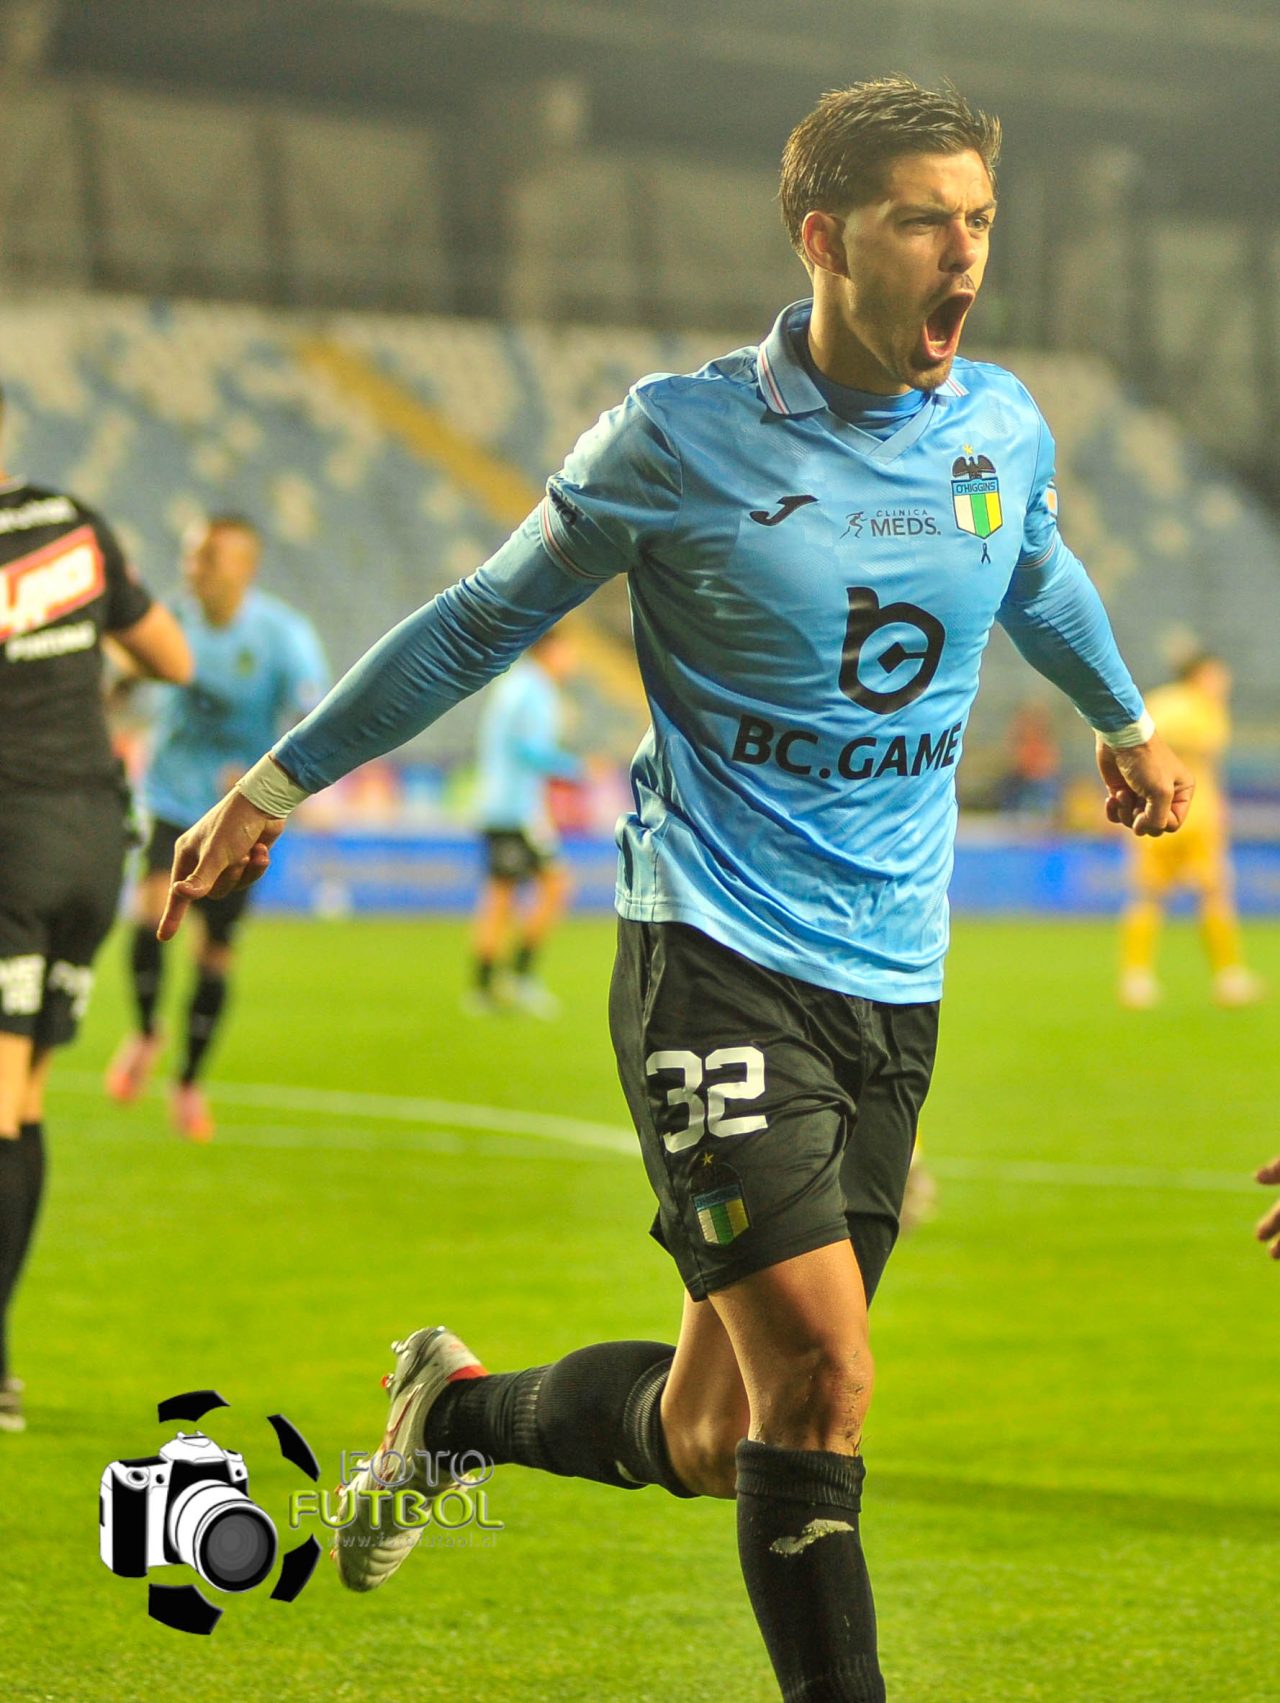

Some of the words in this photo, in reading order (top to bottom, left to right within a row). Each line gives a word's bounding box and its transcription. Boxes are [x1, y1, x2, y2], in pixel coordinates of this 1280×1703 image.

[956, 481, 996, 494] O'HIGGINS
[876, 509, 928, 518] CLINICA
[871, 516, 942, 537] MEDS.
[732, 713, 962, 781] BC.GAME
[645, 1046, 769, 1154] 32
